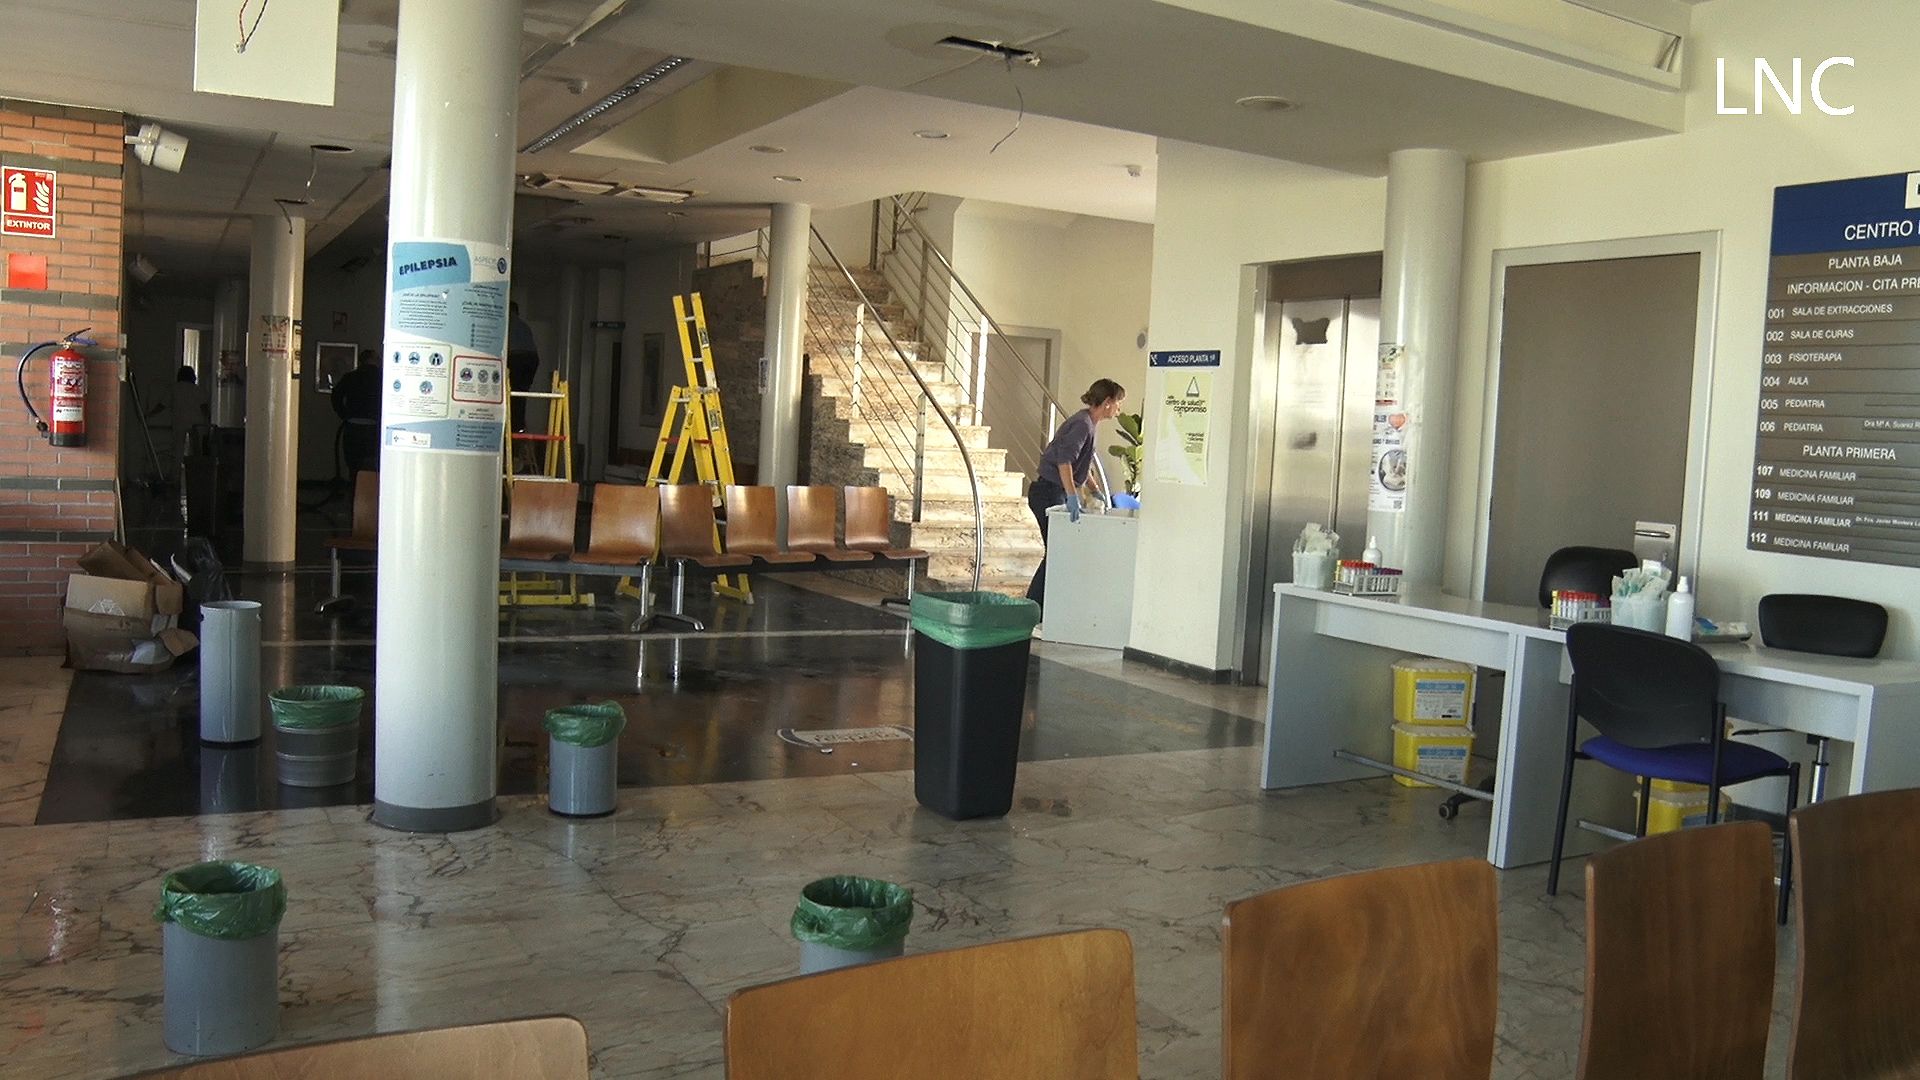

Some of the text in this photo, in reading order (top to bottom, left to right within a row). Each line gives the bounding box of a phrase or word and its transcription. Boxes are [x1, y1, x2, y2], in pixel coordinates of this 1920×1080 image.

[6, 219, 51, 230] EXTINTOR
[1844, 220, 1913, 241] CENTRO
[399, 256, 458, 276] EPILEPSIA
[1828, 254, 1903, 270] PLANTA BAJA
[1787, 280, 1864, 295] INFORMACION
[1872, 278, 1898, 291] CITA
[1768, 304, 1893, 319] 001 SALA DE EXTRACCIONES
[1766, 329, 1854, 342] 002 SALA DE CURAS
[1167, 355, 1188, 364] ACCESO
[1189, 354, 1209, 363] PLANTA
[1764, 353, 1842, 364] 003 FISIOTERAPIA
[1762, 376, 1809, 387] 004 AULA
[1761, 399, 1825, 410] 005 PEDIATRIA
[1759, 421, 1776, 432] 006
[1783, 422, 1824, 433] PEDIATRIA
[1803, 445, 1897, 460] PLANTA PRIMERA
[1756, 466, 1856, 481] 107 MEDICINA FAMILIAR
[1754, 489, 1854, 505] 109 MEDICINA FAMILIAR
[1752, 511, 1769, 521] 111
[1775, 513, 1813, 524] MEDICINA
[1813, 516, 1851, 527] FAMILIAR
[1750, 532, 1850, 552] 112 MEDICINA FAMILIAR
